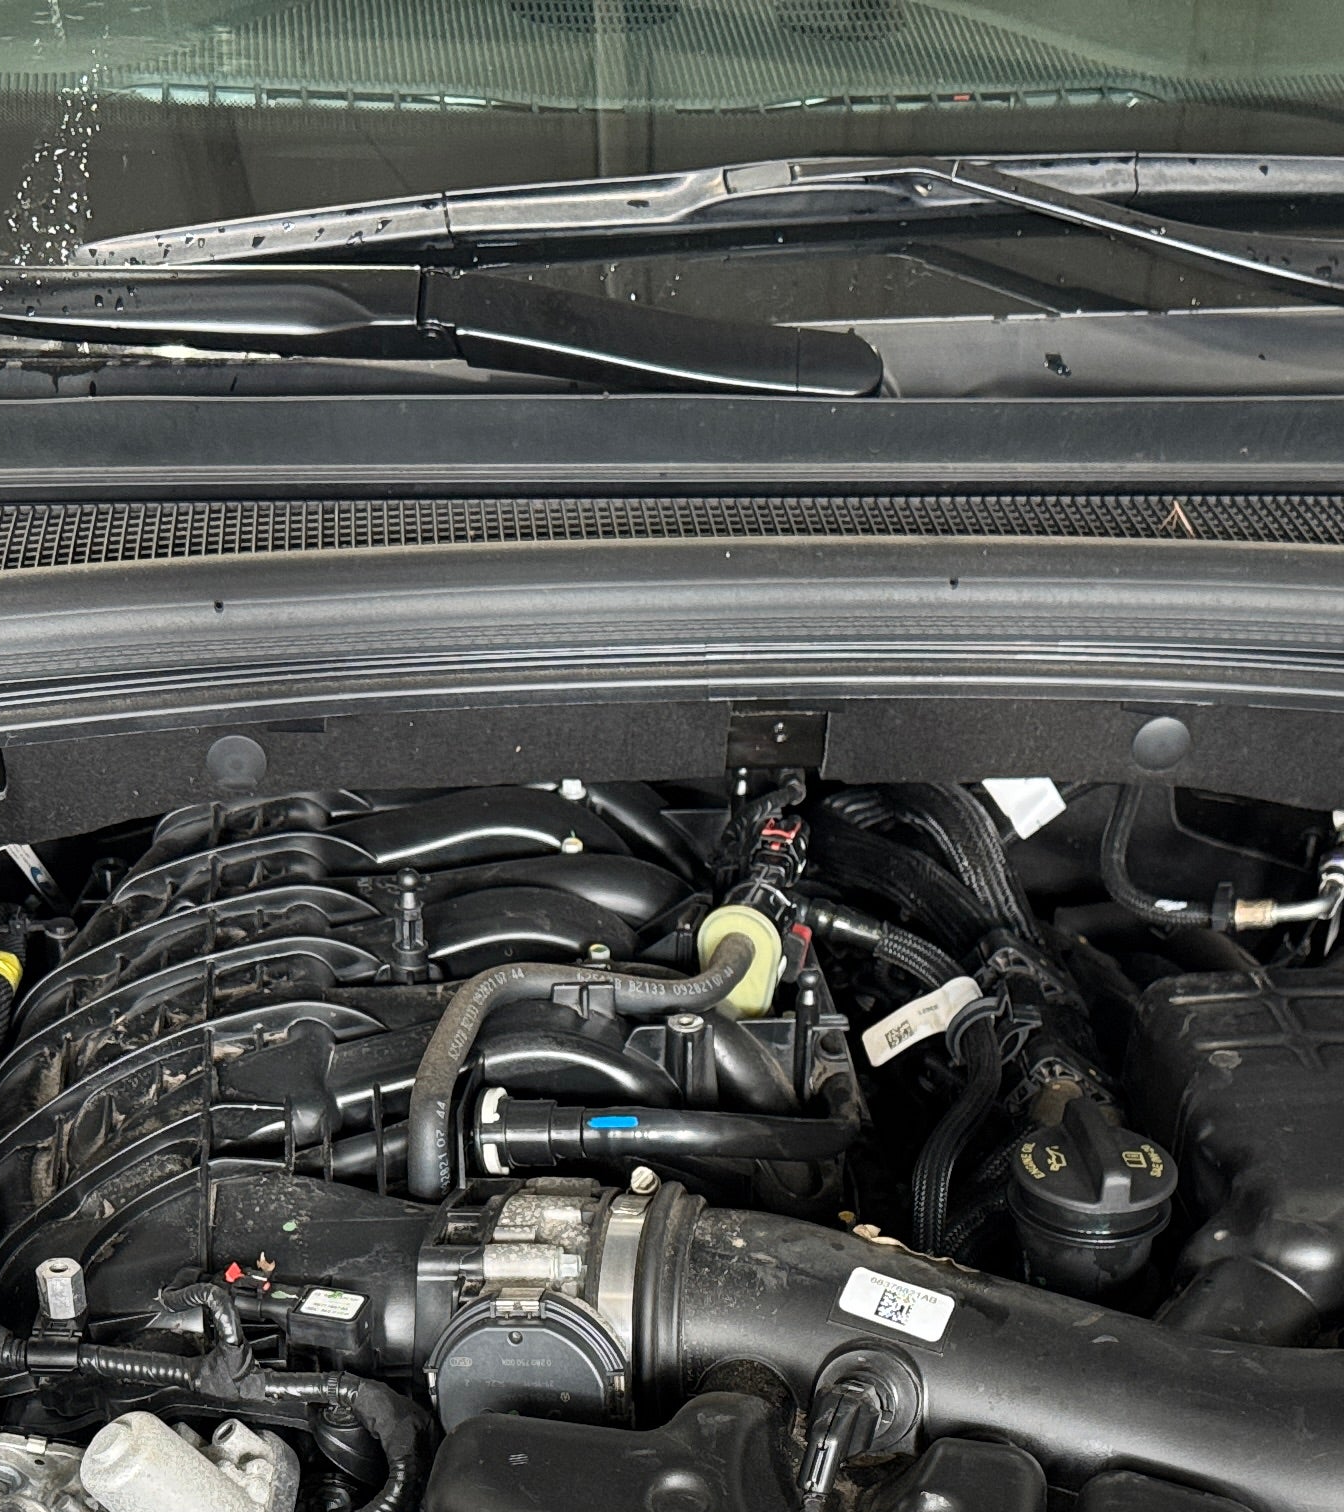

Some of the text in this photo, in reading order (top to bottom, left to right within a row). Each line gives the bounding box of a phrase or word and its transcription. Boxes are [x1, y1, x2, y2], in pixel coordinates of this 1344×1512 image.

[511, 967, 525, 979] 44
[436, 1101, 446, 1119] 44
[436, 1129, 446, 1148] 07
[1020, 1154, 1046, 1179] ENGINE
